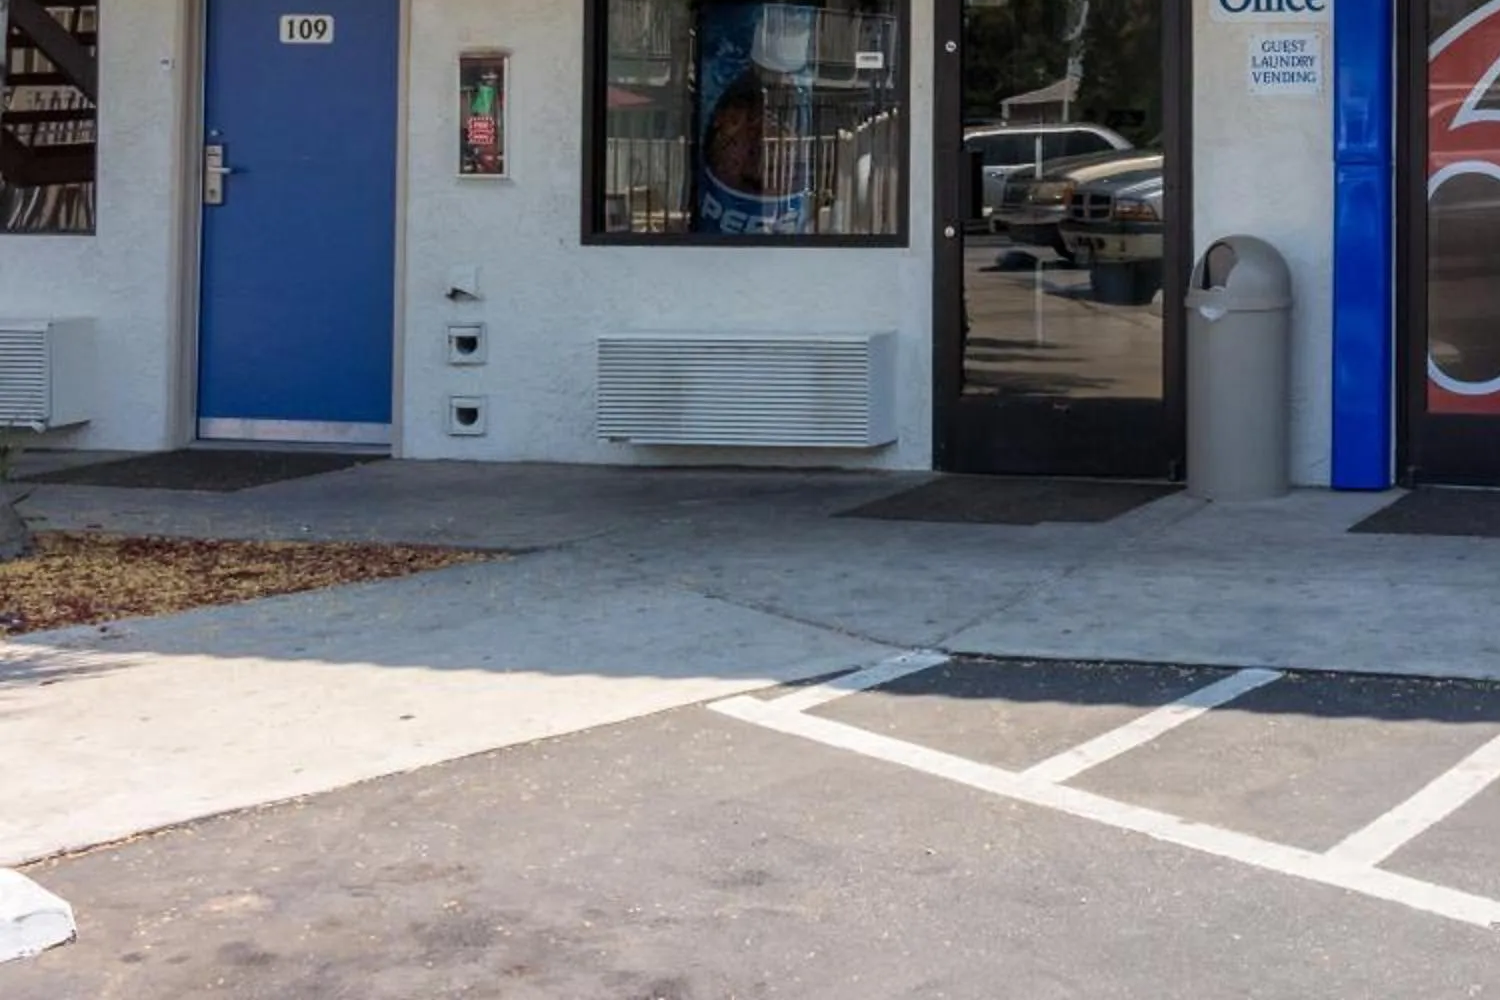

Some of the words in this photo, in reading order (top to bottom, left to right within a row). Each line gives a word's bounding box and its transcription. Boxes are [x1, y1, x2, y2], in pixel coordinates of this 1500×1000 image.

[288, 18, 327, 39] 109
[1261, 39, 1306, 53] GUEST
[1251, 55, 1316, 69] LAUNDRY
[1251, 71, 1317, 84] VENDING
